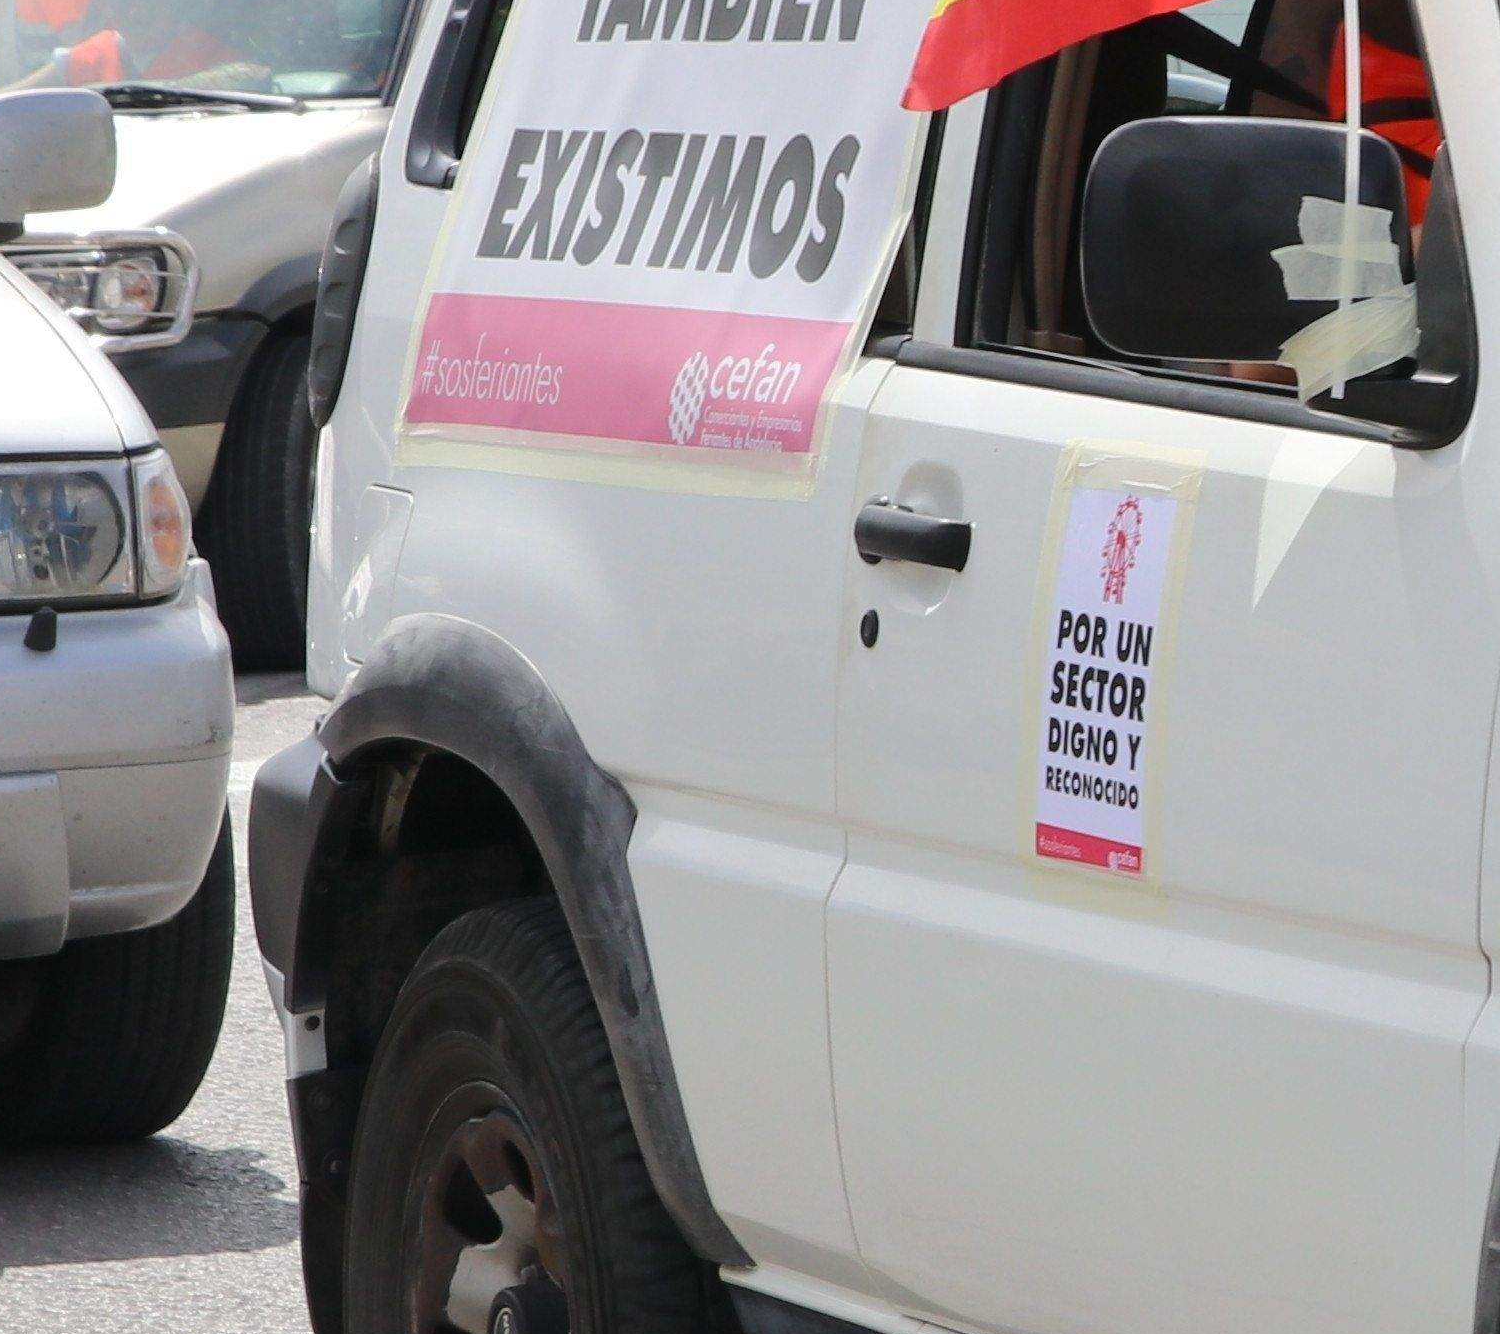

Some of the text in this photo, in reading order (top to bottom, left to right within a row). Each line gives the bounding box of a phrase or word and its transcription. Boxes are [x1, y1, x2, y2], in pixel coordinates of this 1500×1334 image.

[475, 128, 863, 284] EXISTIMOS
[421, 331, 564, 407] #sosferiantes
[709, 342, 802, 406] cefan
[1056, 608, 1154, 667] POR UN
[1049, 660, 1147, 723] SECTOR
[1047, 716, 1143, 772] DIGNO Y
[1045, 765, 1140, 811] RECONOCIDO
